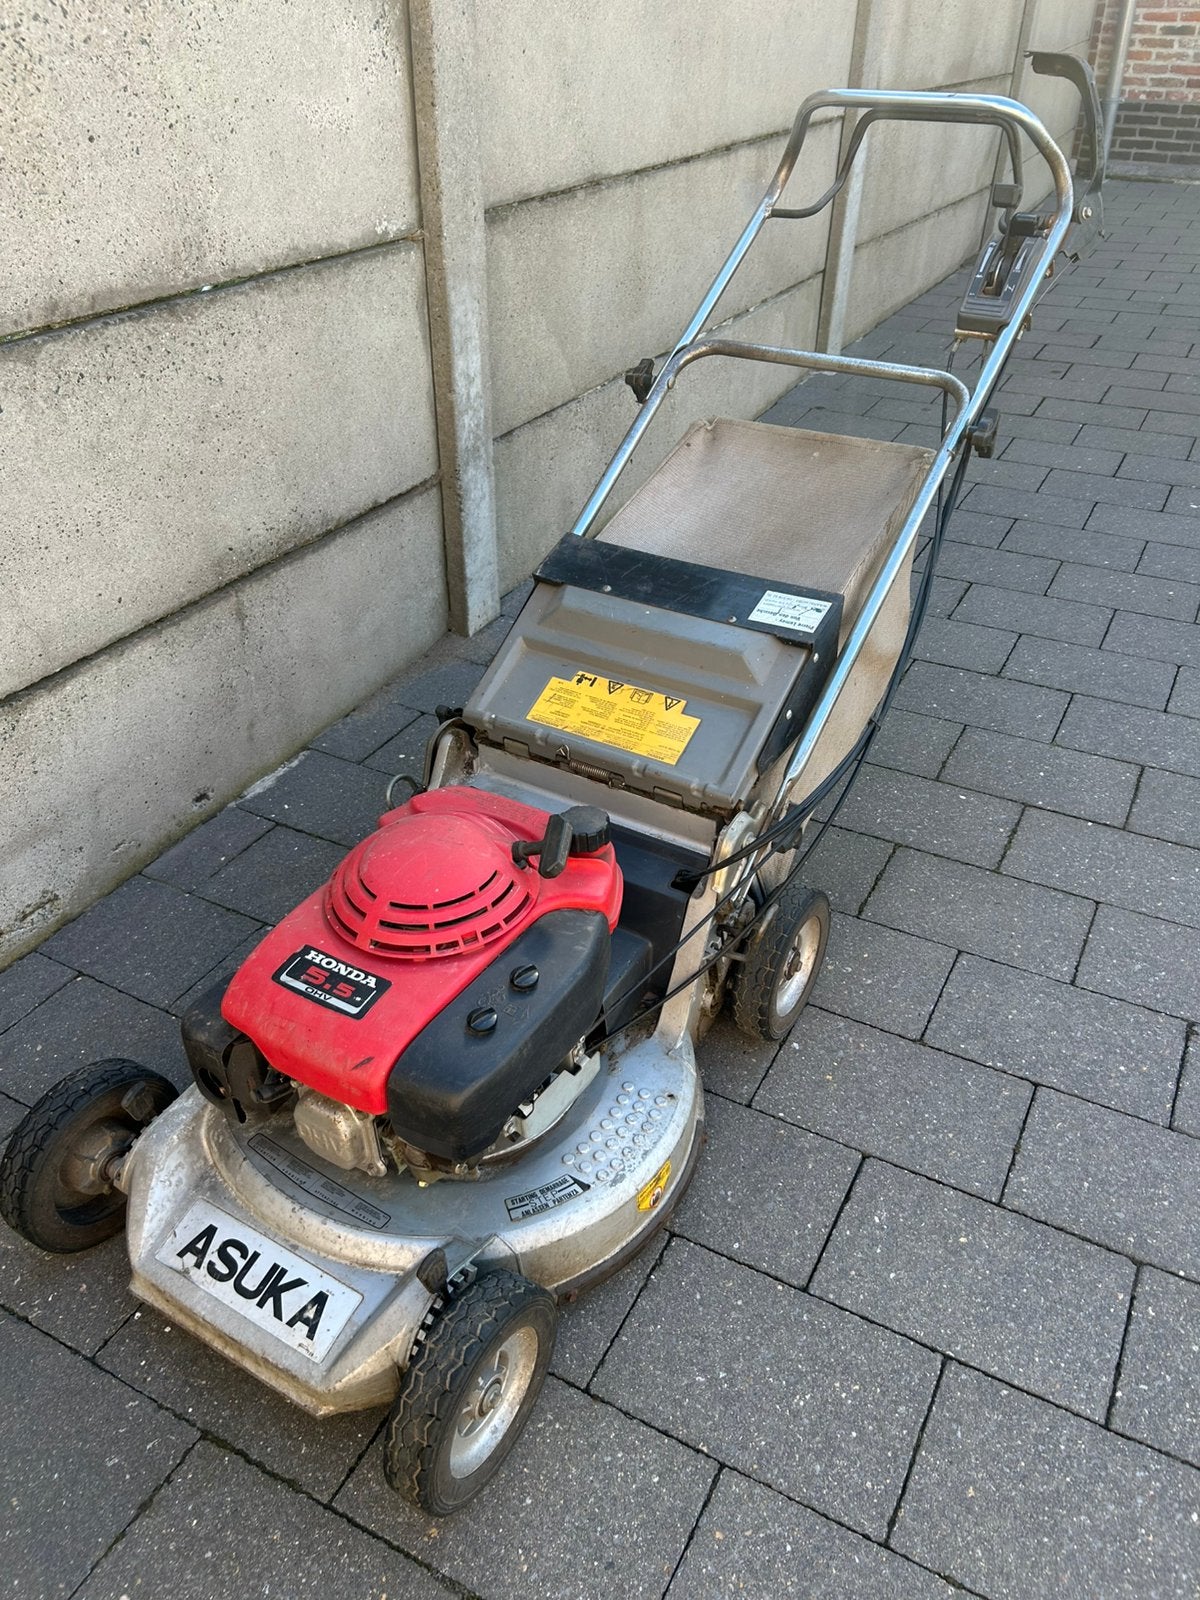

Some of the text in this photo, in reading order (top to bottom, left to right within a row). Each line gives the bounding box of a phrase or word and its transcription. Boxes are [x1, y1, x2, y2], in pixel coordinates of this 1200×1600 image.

[301, 965, 357, 999] 5.5
[304, 950, 377, 988] HONDA
[304, 986, 332, 1001] OHV
[510, 1191, 538, 1206] STARTING
[521, 1188, 580, 1219] ANLASSEN PARTENZA
[528, 1189, 558, 1209] STEP
[176, 1223, 330, 1342] ASUKA
